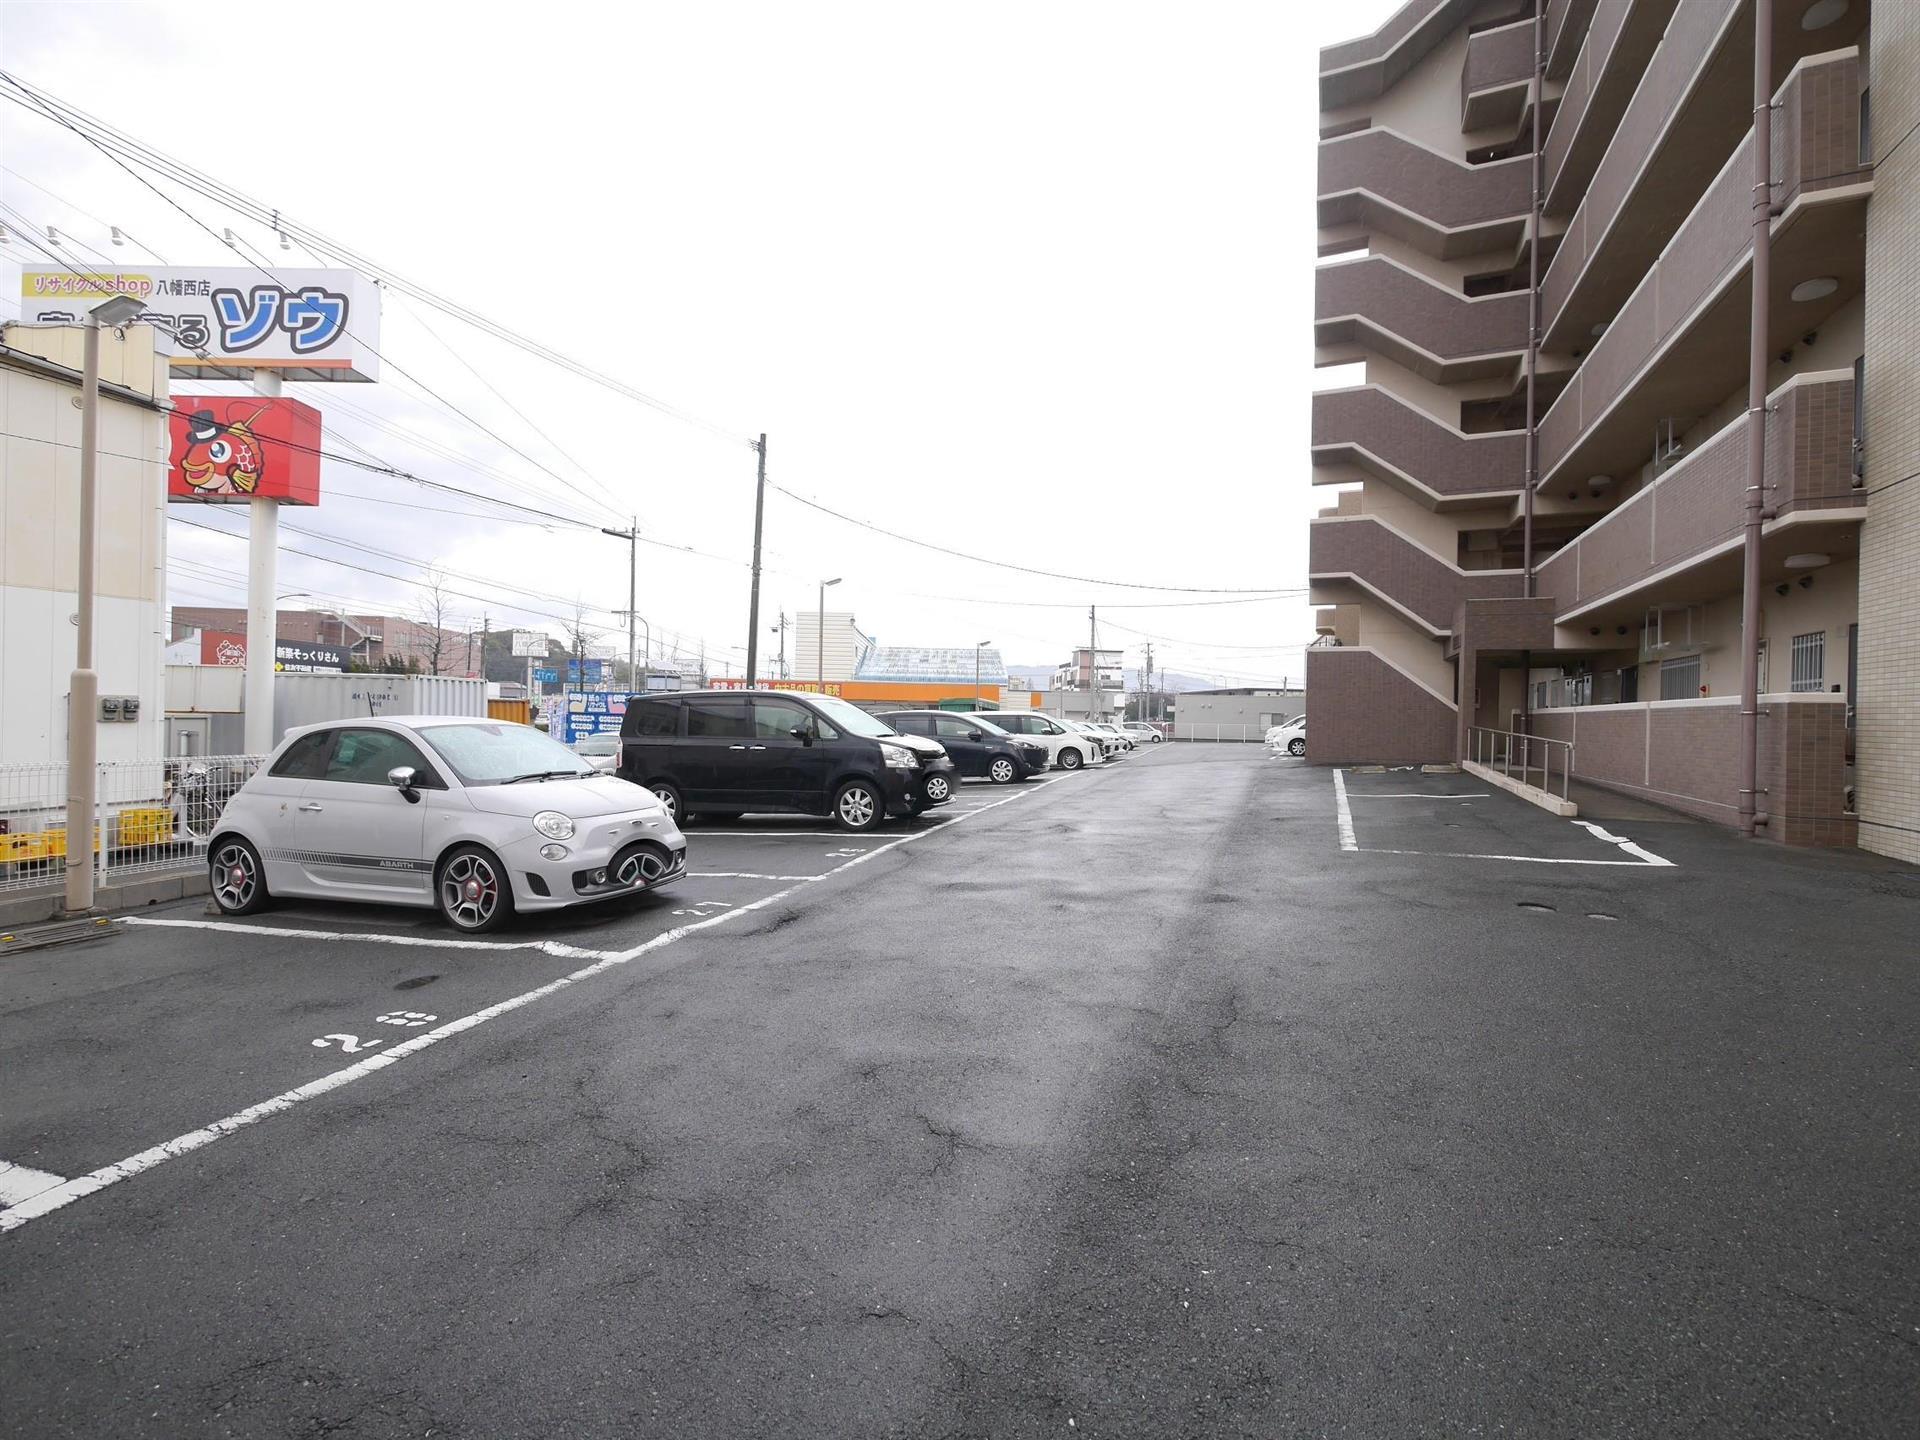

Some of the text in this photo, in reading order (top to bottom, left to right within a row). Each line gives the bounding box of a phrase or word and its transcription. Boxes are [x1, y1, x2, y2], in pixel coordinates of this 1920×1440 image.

[156, 279, 211, 297] 八幡西店
[211, 285, 349, 354] ゾウ
[276, 646, 339, 663] 新築そっくりさん
[379, 860, 414, 869] ABARTH
[311, 1010, 438, 1054] 28
